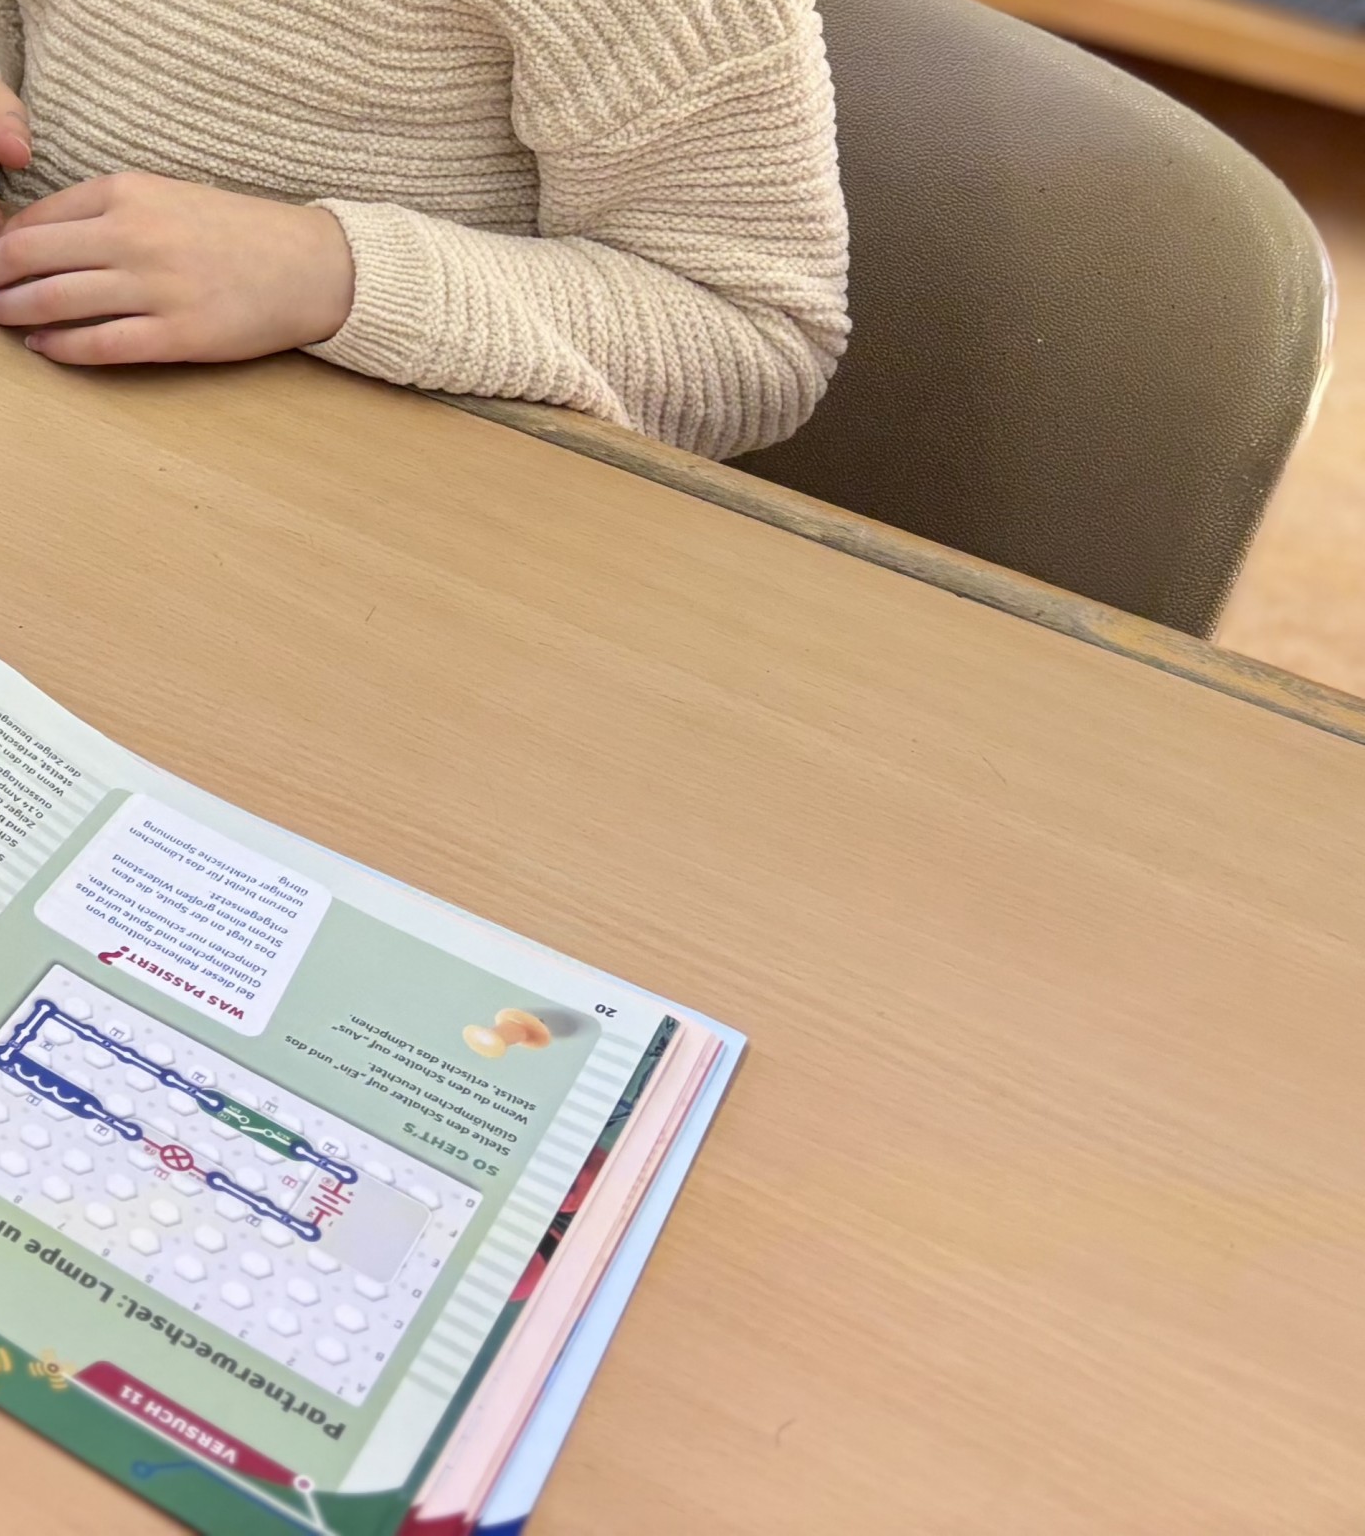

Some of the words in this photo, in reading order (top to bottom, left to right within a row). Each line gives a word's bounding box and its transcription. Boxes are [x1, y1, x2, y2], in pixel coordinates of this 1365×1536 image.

[128, 826, 185, 862] Lämpchen
[142, 819, 197, 855] Spannung
[110, 866, 136, 884] dem
[111, 853, 174, 892] Widerstand
[184, 857, 206, 872] das
[196, 850, 257, 884] elektrische
[204, 869, 225, 882] für
[74, 881, 96, 898] das
[87, 873, 136, 908] leuchten.
[134, 880, 154, 894] die
[223, 877, 257, 899] bleibt
[257, 881, 304, 907] weniger
[277, 875, 309, 897] übrig.
[84, 903, 106, 920] von
[94, 894, 122, 913] wird
[155, 889, 189, 914] Spule,
[174, 887, 217, 912] großen
[257, 894, 298, 919] Darum
[121, 909, 155, 932] Spule
[136, 903, 186, 933] schwach
[187, 910, 209, 923] der
[209, 891, 288, 934] entgegensetzt.
[215, 908, 247, 928] einen
[152, 927, 178, 944] und
[184, 930, 208, 944] nur
[209, 919, 226, 932] an
[225, 928, 253, 947] liegt
[246, 924, 284, 948] Strom
[106, 915, 199, 971] Reihenschaltung
[252, 942, 277, 959] Das
[177, 940, 261, 988] Glühlämpchen
[207, 940, 268, 977] Lämpchen
[96, 945, 205, 998] PASSIERT?
[199, 967, 236, 988] dieser
[234, 985, 255, 1000] Bei
[206, 994, 244, 1020] WAS
[593, 1002, 618, 1018] 20
[284, 1034, 308, 1050] das
[349, 1013, 415, 1053] Lämpchen.
[306, 1047, 333, 1064] und
[366, 1038, 391, 1055] auf
[415, 1048, 440, 1064] das
[367, 1061, 422, 1096] leuchtet.
[391, 1052, 446, 1084] Schalter
[439, 1059, 489, 1088] erlischt
[363, 1075, 389, 1093] auf
[446, 1078, 472, 1095] den
[389, 1090, 444, 1123] Schalter
[472, 1091, 491, 1105] du
[492, 1084, 537, 1111] stellst,
[422, 1090, 517, 1143] Glühlämpchen
[491, 1101, 528, 1125] Wenn
[445, 1117, 471, 1135] den
[470, 1130, 511, 1156] Stelle
[471, 1157, 500, 1177] SO
[23, 1238, 114, 1303] Lampe
[117, 1295, 345, 1440] Partnerwechsel:
[118, 1384, 141, 1408] 11
[144, 1401, 239, 1465] VERSUCH
